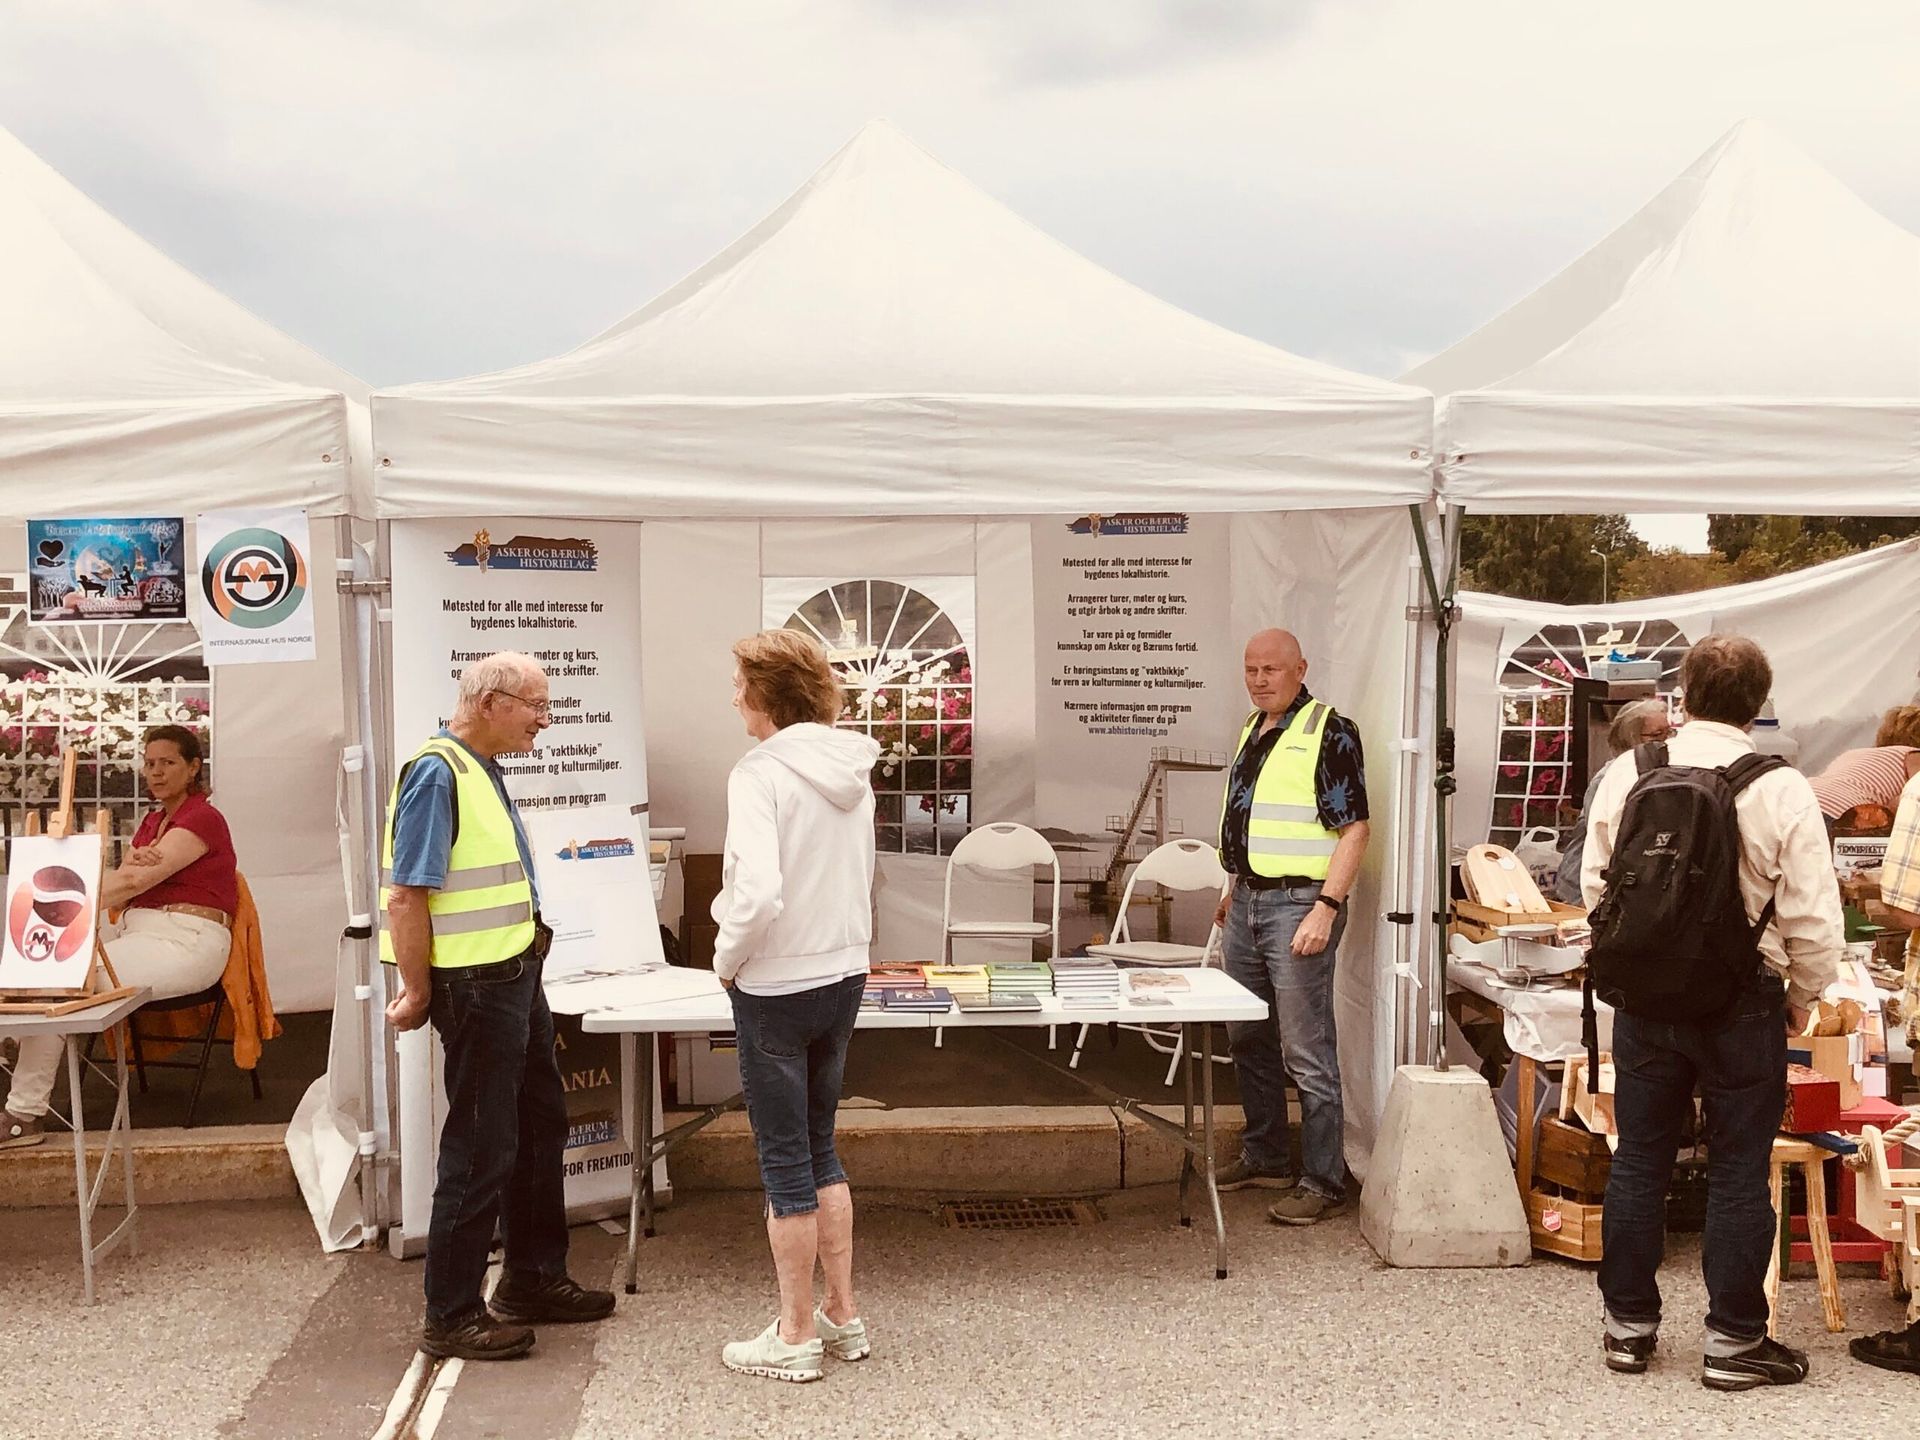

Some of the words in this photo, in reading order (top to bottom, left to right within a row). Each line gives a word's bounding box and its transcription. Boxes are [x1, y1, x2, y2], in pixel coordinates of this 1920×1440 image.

[1105, 518, 1133, 526] ASKER
[1135, 518, 1149, 526] OG
[1150, 517, 1182, 526] BÆRUM
[1123, 525, 1182, 534] HISTORIELAG
[496, 547, 532, 558] ASKER
[533, 548, 549, 559] OG
[551, 549, 590, 560] BÆRUM
[519, 557, 590, 569] HISTORIELAG
[1062, 557, 1096, 567] Møtested
[1098, 557, 1109, 567] for
[1111, 557, 1125, 567] alle
[1127, 557, 1143, 567] med
[1145, 557, 1179, 567] interesse
[1181, 556, 1192, 566] for
[1084, 569, 1119, 580] bygdenes
[1121, 568, 1170, 578] lokalhistorie.
[1067, 594, 1108, 605] Arrangerer
[1110, 594, 1131, 604] turer,
[1133, 594, 1156, 604] møter
[1157, 595, 1167, 605] og
[1168, 593, 1187, 604] kurs,
[442, 599, 485, 612] Møtested
[488, 600, 502, 612] for
[504, 600, 523, 612] alle
[525, 600, 545, 613] med
[547, 600, 588, 613] interesse
[591, 600, 604, 613] for
[1068, 607, 1077, 617] og
[1079, 606, 1096, 617] utgir
[1099, 605, 1121, 615] årbok
[1122, 607, 1132, 617] og
[1134, 606, 1155, 615] andre
[1157, 605, 1187, 616] skrifter.
[470, 616, 516, 630] bygdenes
[518, 616, 577, 629] lokalhistorie.
[209, 637, 270, 647] INTERNASJONALE
[288, 635, 313, 643] NORGE
[1082, 629, 1094, 639] Tar
[1096, 631, 1113, 639] vare
[1115, 629, 1125, 641] på
[1127, 631, 1136, 641] og
[1138, 629, 1172, 639] formidler
[1057, 641, 1092, 652] kunnskap
[1094, 642, 1106, 651] om
[1108, 641, 1130, 651] Asker
[1132, 642, 1141, 652] og
[1143, 642, 1173, 651] Bærums
[1175, 641, 1198, 652] fortid.
[534, 650, 560, 661] møter
[563, 651, 574, 663] og
[576, 649, 599, 661] kurs,
[451, 669, 462, 681] og
[541, 665, 560, 677] dre
[563, 664, 599, 676] skrifter.
[1063, 665, 1072, 675] Er
[1073, 665, 1128, 677] høringsinstans
[1130, 668, 1139, 677] og
[1142, 665, 1189, 677] "vaktbikkje"
[1051, 677, 1062, 686] for
[1063, 678, 1080, 687] vern
[1081, 679, 1090, 687] av
[1092, 677, 1141, 688] kulturminner
[1143, 679, 1153, 689] og
[1154, 678, 1206, 689] kulturmiljøer.
[549, 697, 582, 709] rmidler
[1064, 701, 1098, 711] Nærmere
[1100, 701, 1145, 713] informasjon
[1147, 703, 1159, 712] om
[1160, 703, 1192, 714] program
[548, 713, 584, 725] Bærums
[585, 711, 613, 724] fortid.
[1079, 714, 1088, 724] og
[1090, 713, 1130, 723] aktiviteter
[1132, 714, 1154, 724] finner
[1156, 714, 1166, 724] du
[1168, 714, 1177, 726] på
[1088, 725, 1168, 738] www.abhistorielag.no
[532, 749, 543, 760] og
[546, 743, 603, 758] "vaktbikkje"
[502, 763, 545, 776] urminner
[548, 763, 559, 775] og
[561, 760, 622, 774] kulturmiljøer.
[553, 796, 566, 805] om
[569, 793, 606, 806] program
[581, 845, 599, 853] ASKER
[593, 849, 631, 858] HISTORIELAG
[569, 1121, 609, 1135] BÆRUM
[564, 1161, 584, 1178] FOR
[587, 1152, 634, 1174] FREMTID
